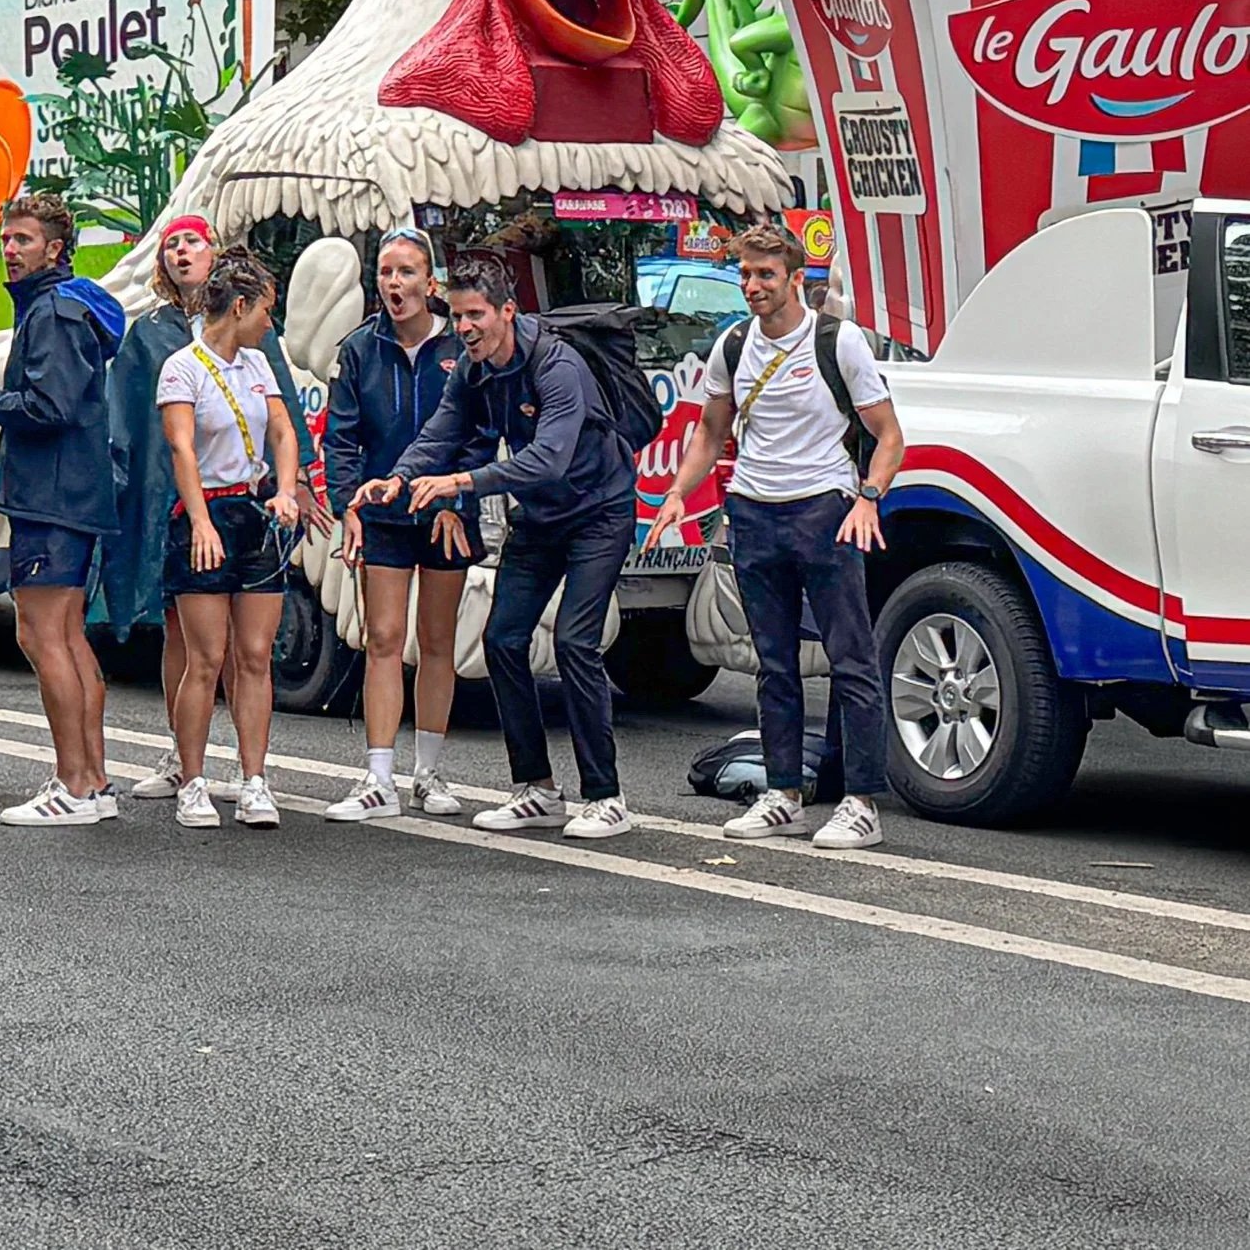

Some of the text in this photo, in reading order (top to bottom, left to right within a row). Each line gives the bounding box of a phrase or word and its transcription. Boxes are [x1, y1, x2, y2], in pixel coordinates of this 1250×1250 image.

[973, 15, 1014, 63] le
[839, 116, 912, 156] CROUSTY
[848, 157, 922, 199] CHICKEN
